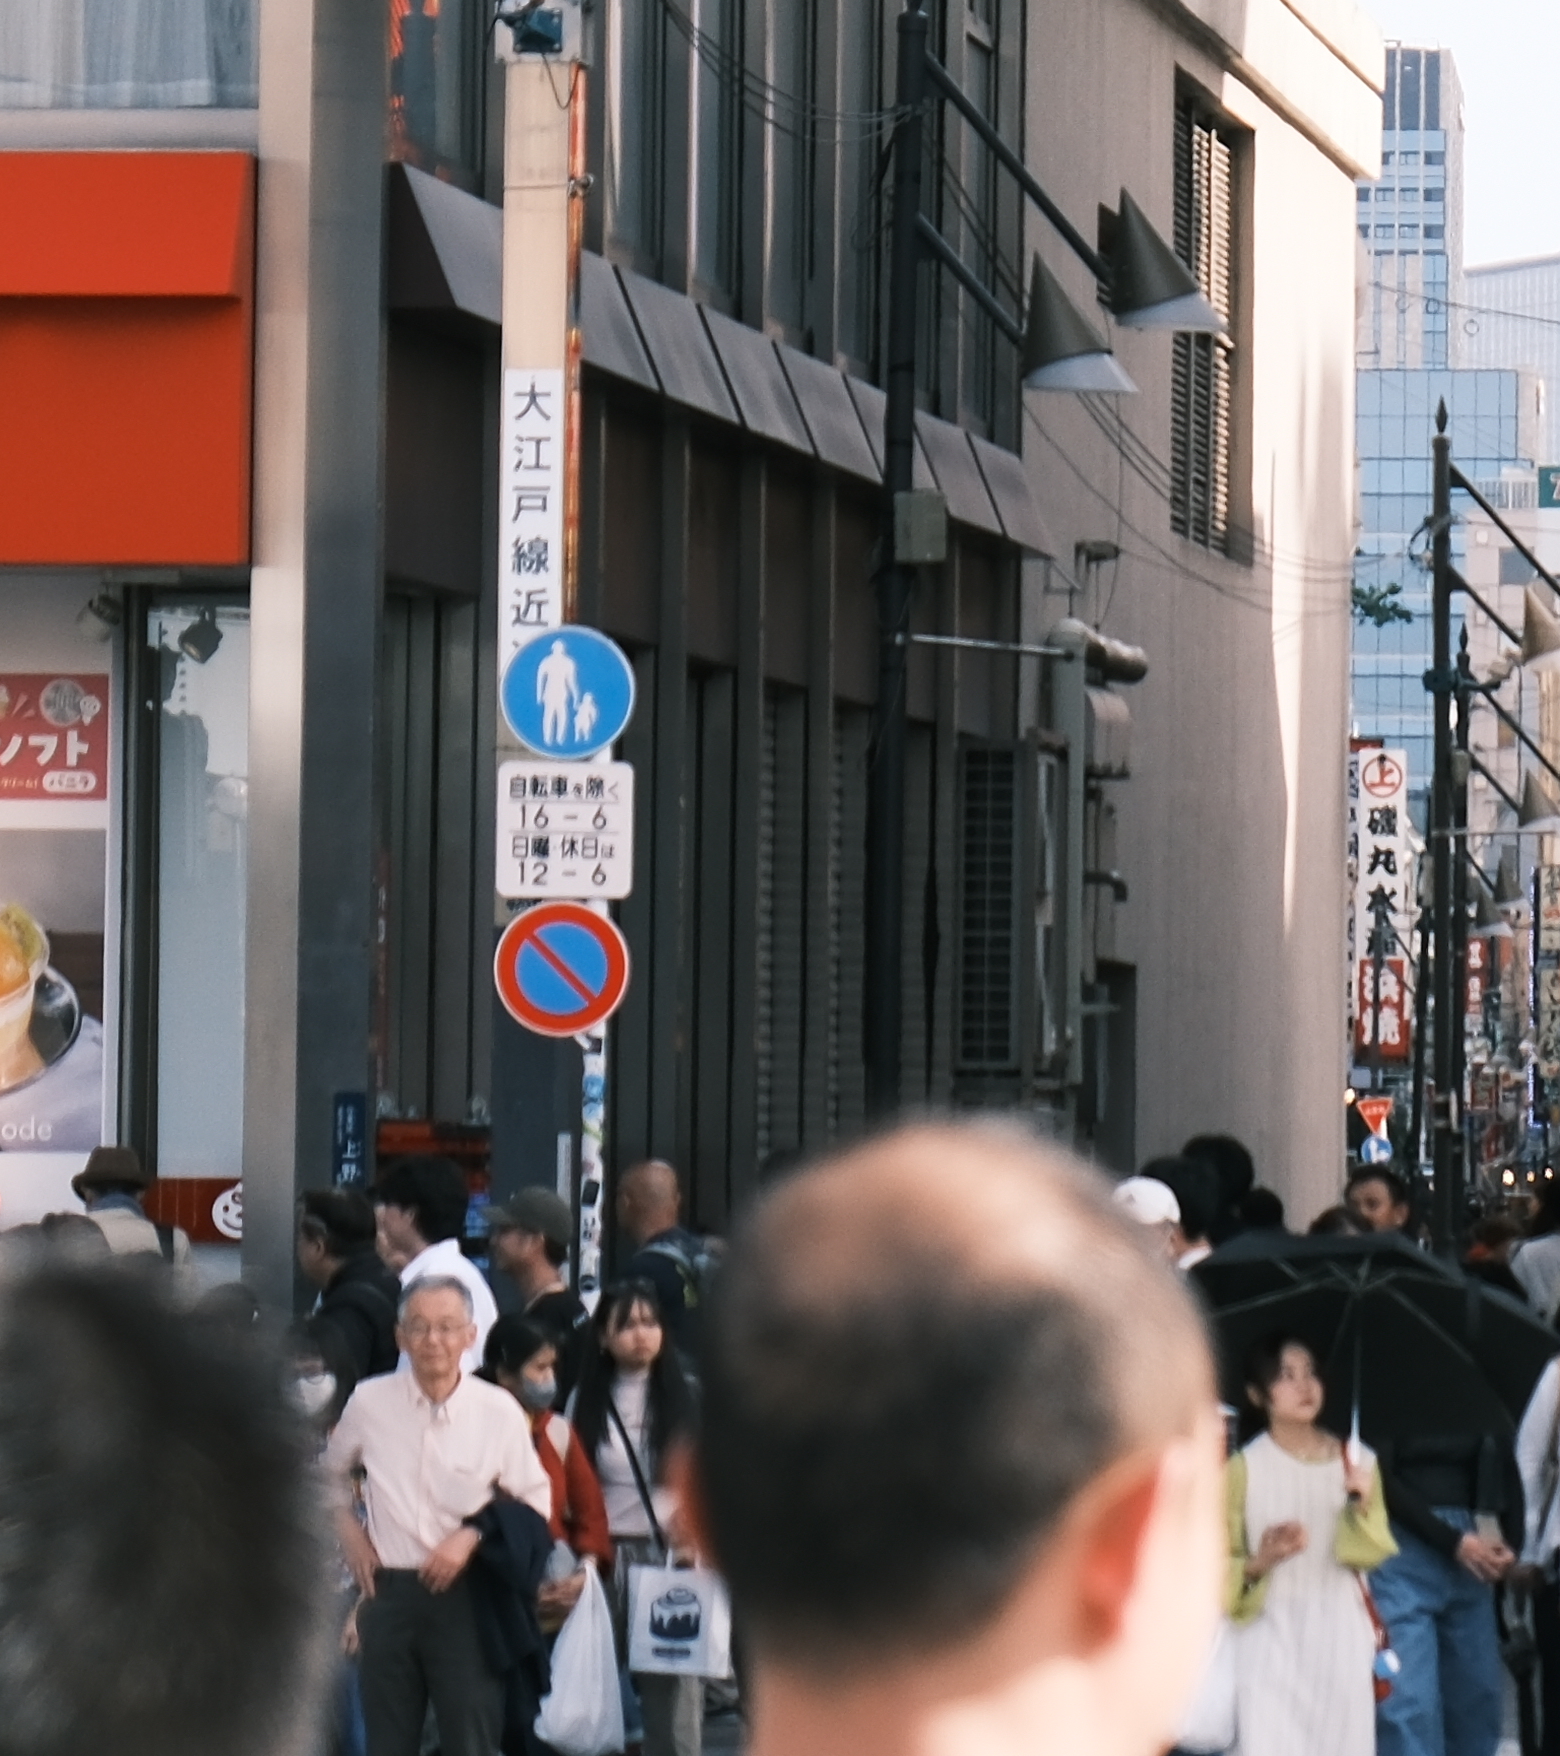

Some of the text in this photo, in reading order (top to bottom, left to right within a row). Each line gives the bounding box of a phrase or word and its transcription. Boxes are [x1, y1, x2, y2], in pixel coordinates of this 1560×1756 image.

[511, 380, 553, 632] 大江戸線近
